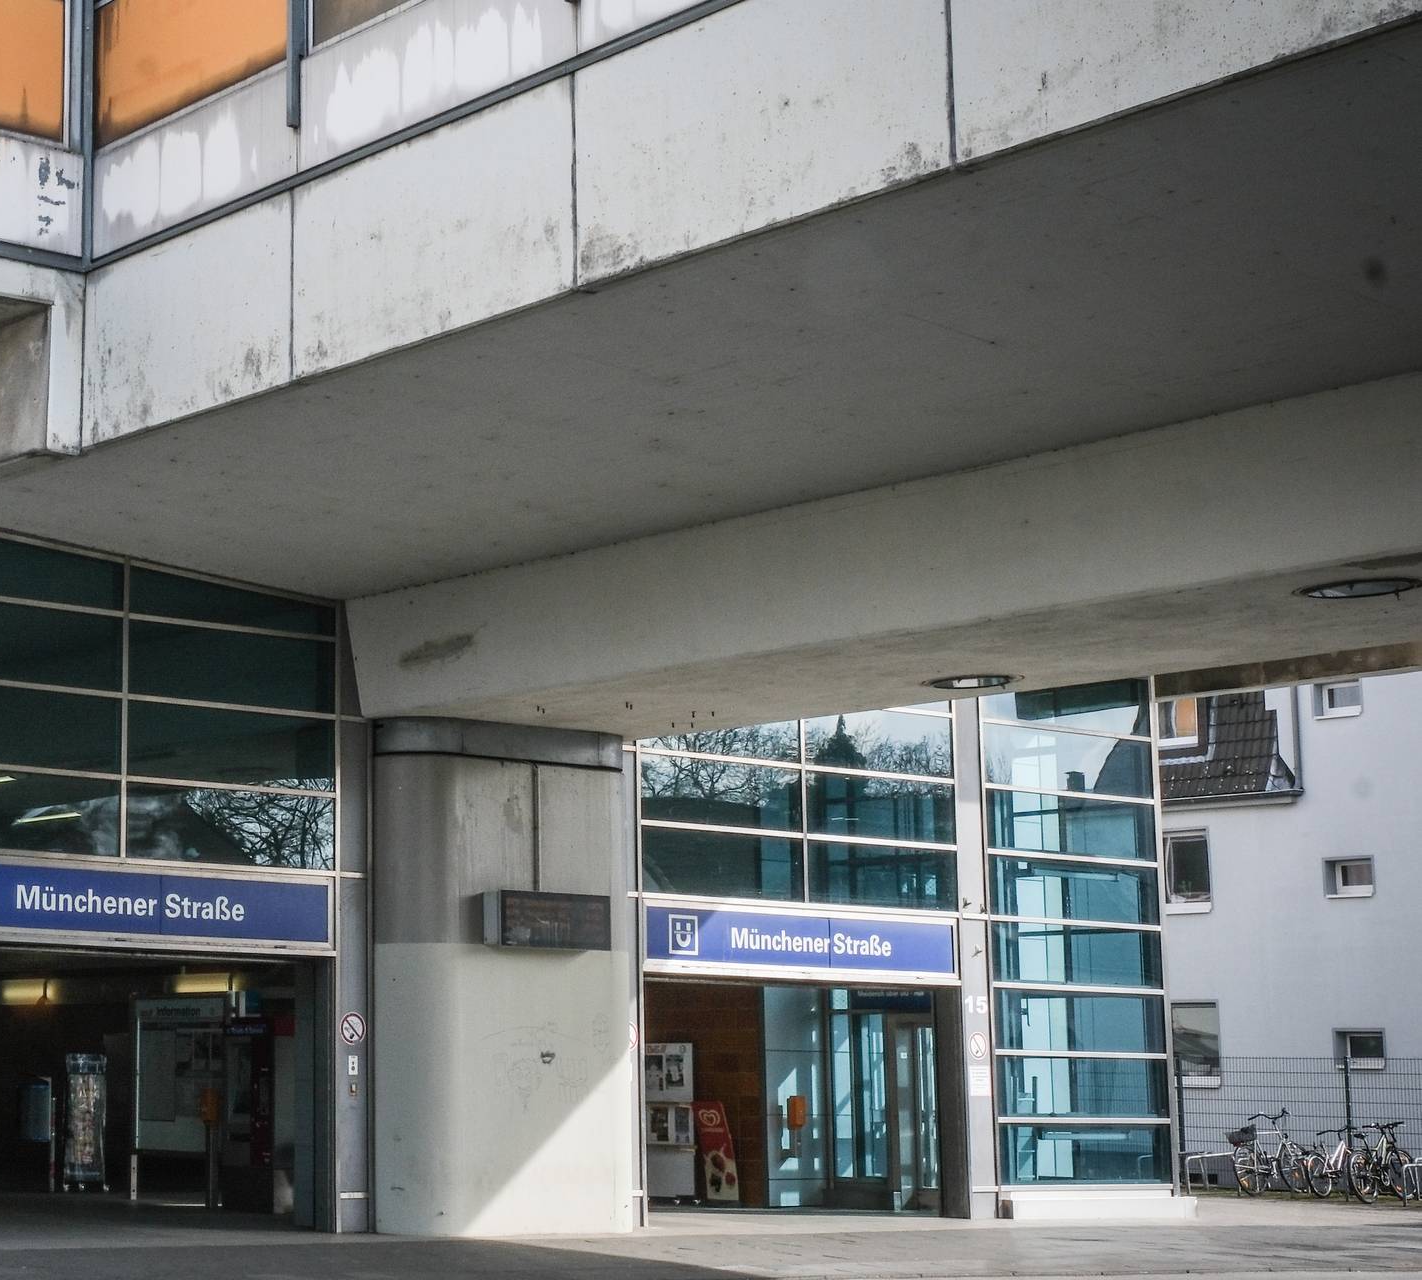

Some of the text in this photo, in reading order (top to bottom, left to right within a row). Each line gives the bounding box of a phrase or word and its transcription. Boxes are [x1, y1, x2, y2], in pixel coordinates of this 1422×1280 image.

[16, 884, 245, 922] Münchener Straße
[731, 927, 892, 957] Münchener Straße
[964, 995, 988, 1014] 15
